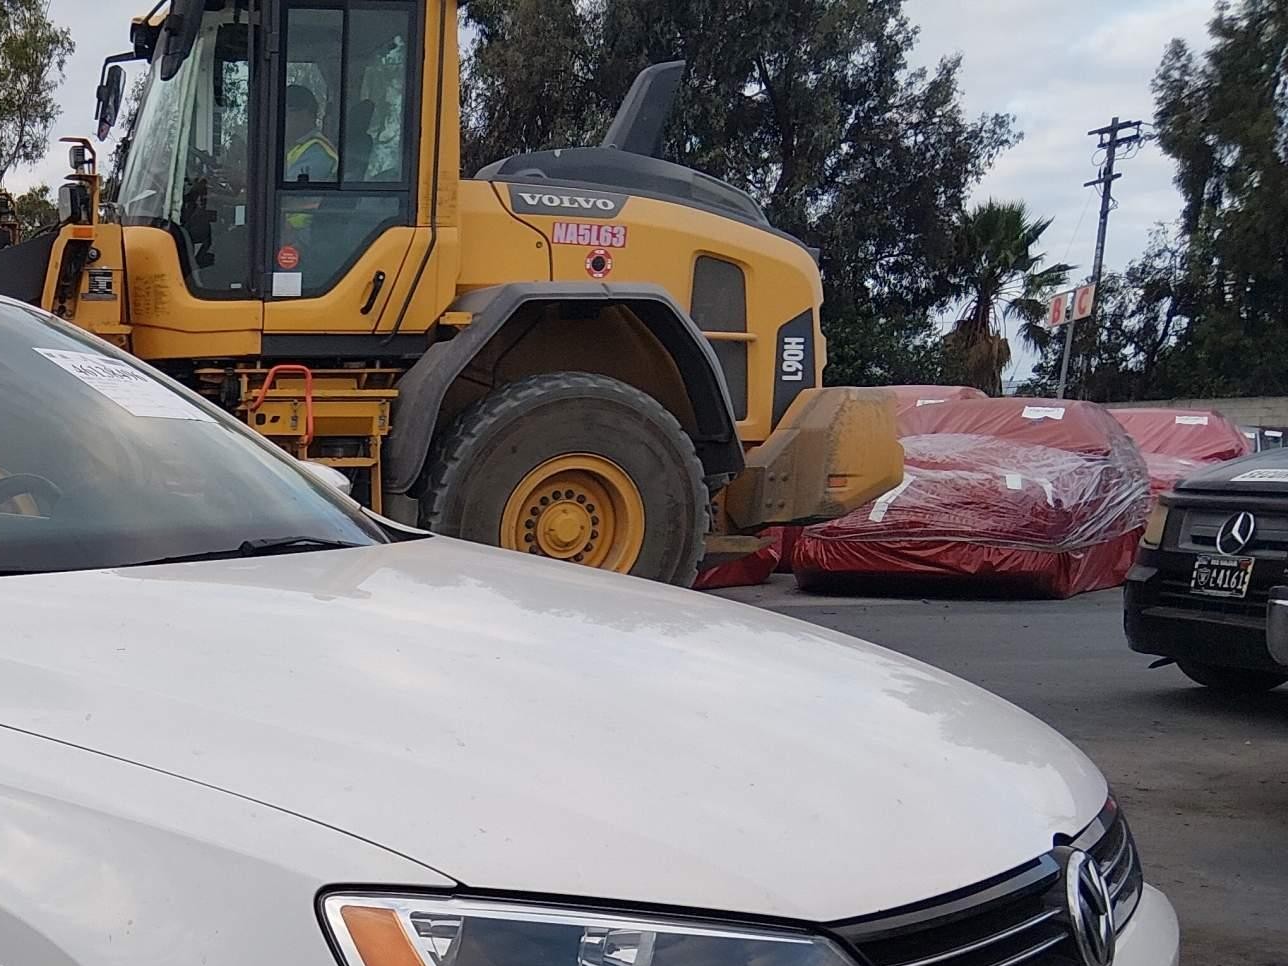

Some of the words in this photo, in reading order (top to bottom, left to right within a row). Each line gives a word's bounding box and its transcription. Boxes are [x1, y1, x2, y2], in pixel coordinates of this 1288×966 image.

[518, 193, 615, 210] VOLVO
[553, 222, 626, 247] NA5L63
[1078, 287, 1090, 315] C
[782, 337, 805, 380] L90H
